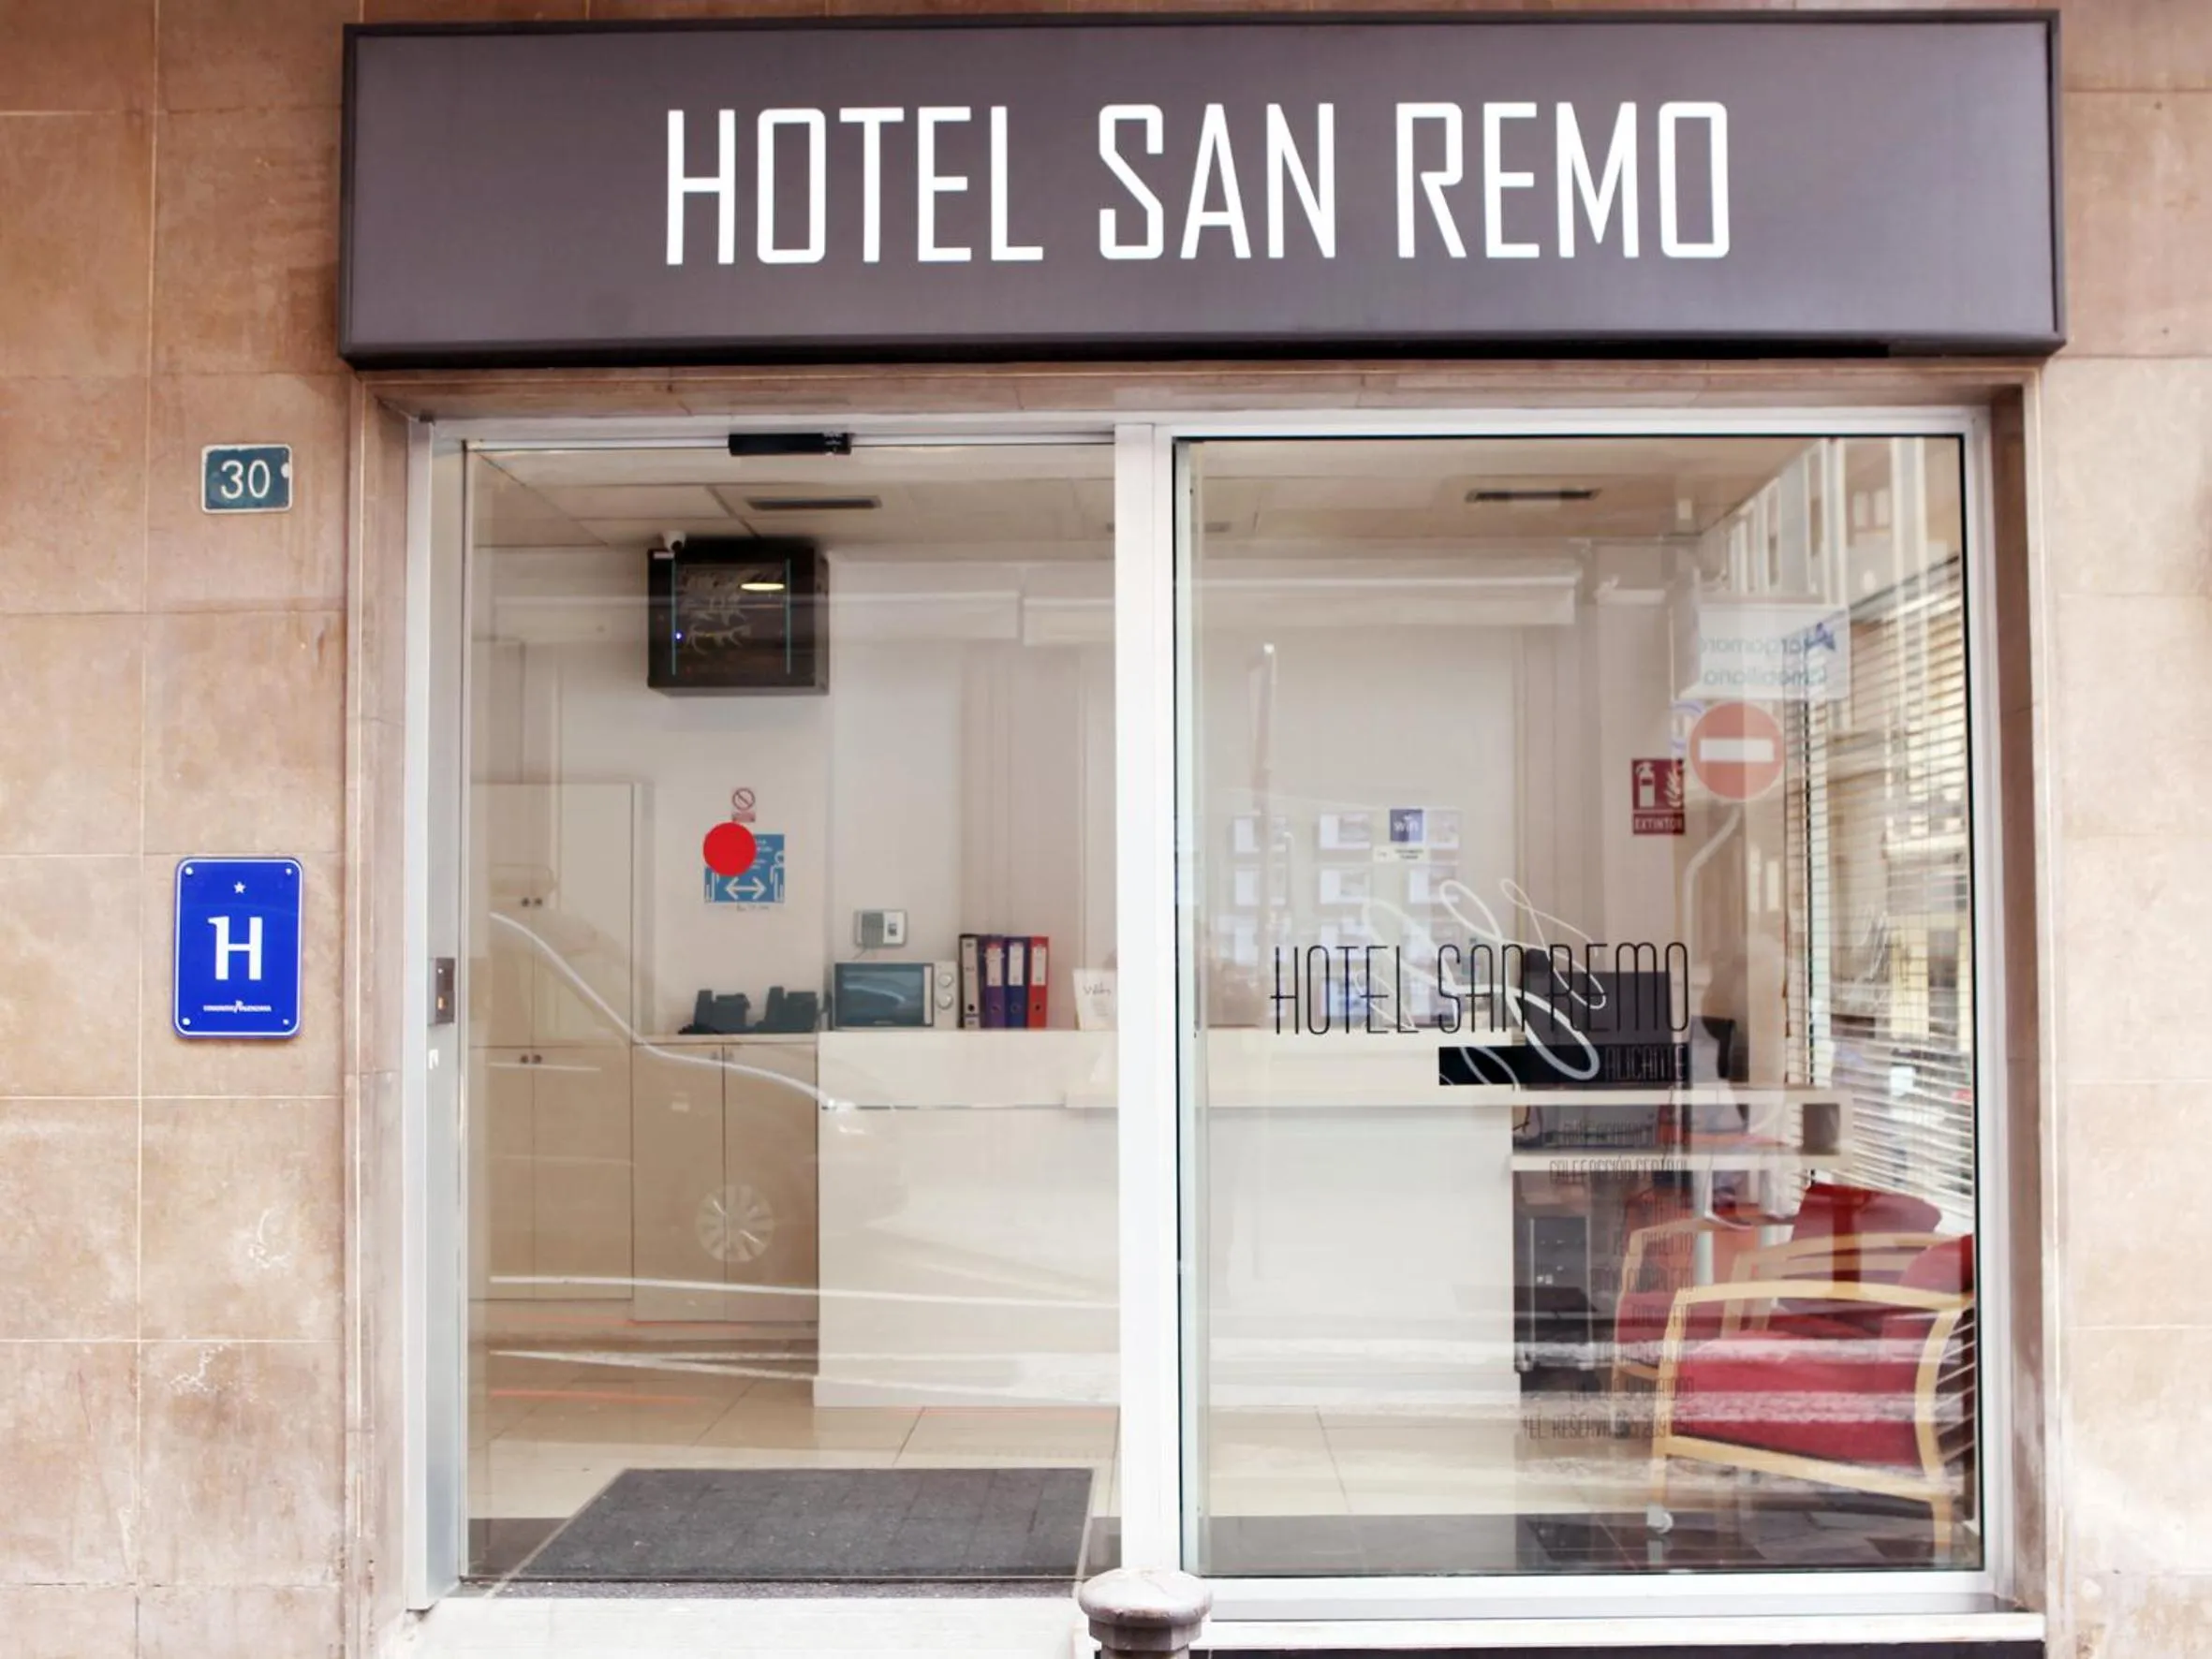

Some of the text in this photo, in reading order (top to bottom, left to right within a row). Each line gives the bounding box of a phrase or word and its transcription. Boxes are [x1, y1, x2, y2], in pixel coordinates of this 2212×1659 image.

[667, 101, 1730, 265] HOTEL SAN REMO
[221, 459, 271, 499] 30
[1635, 817, 1683, 830] EXTINTOR
[208, 916, 263, 981] H
[1270, 941, 1689, 1035] HOTEL SAN REMO
[1605, 1044, 1685, 1081] ALICANTE
